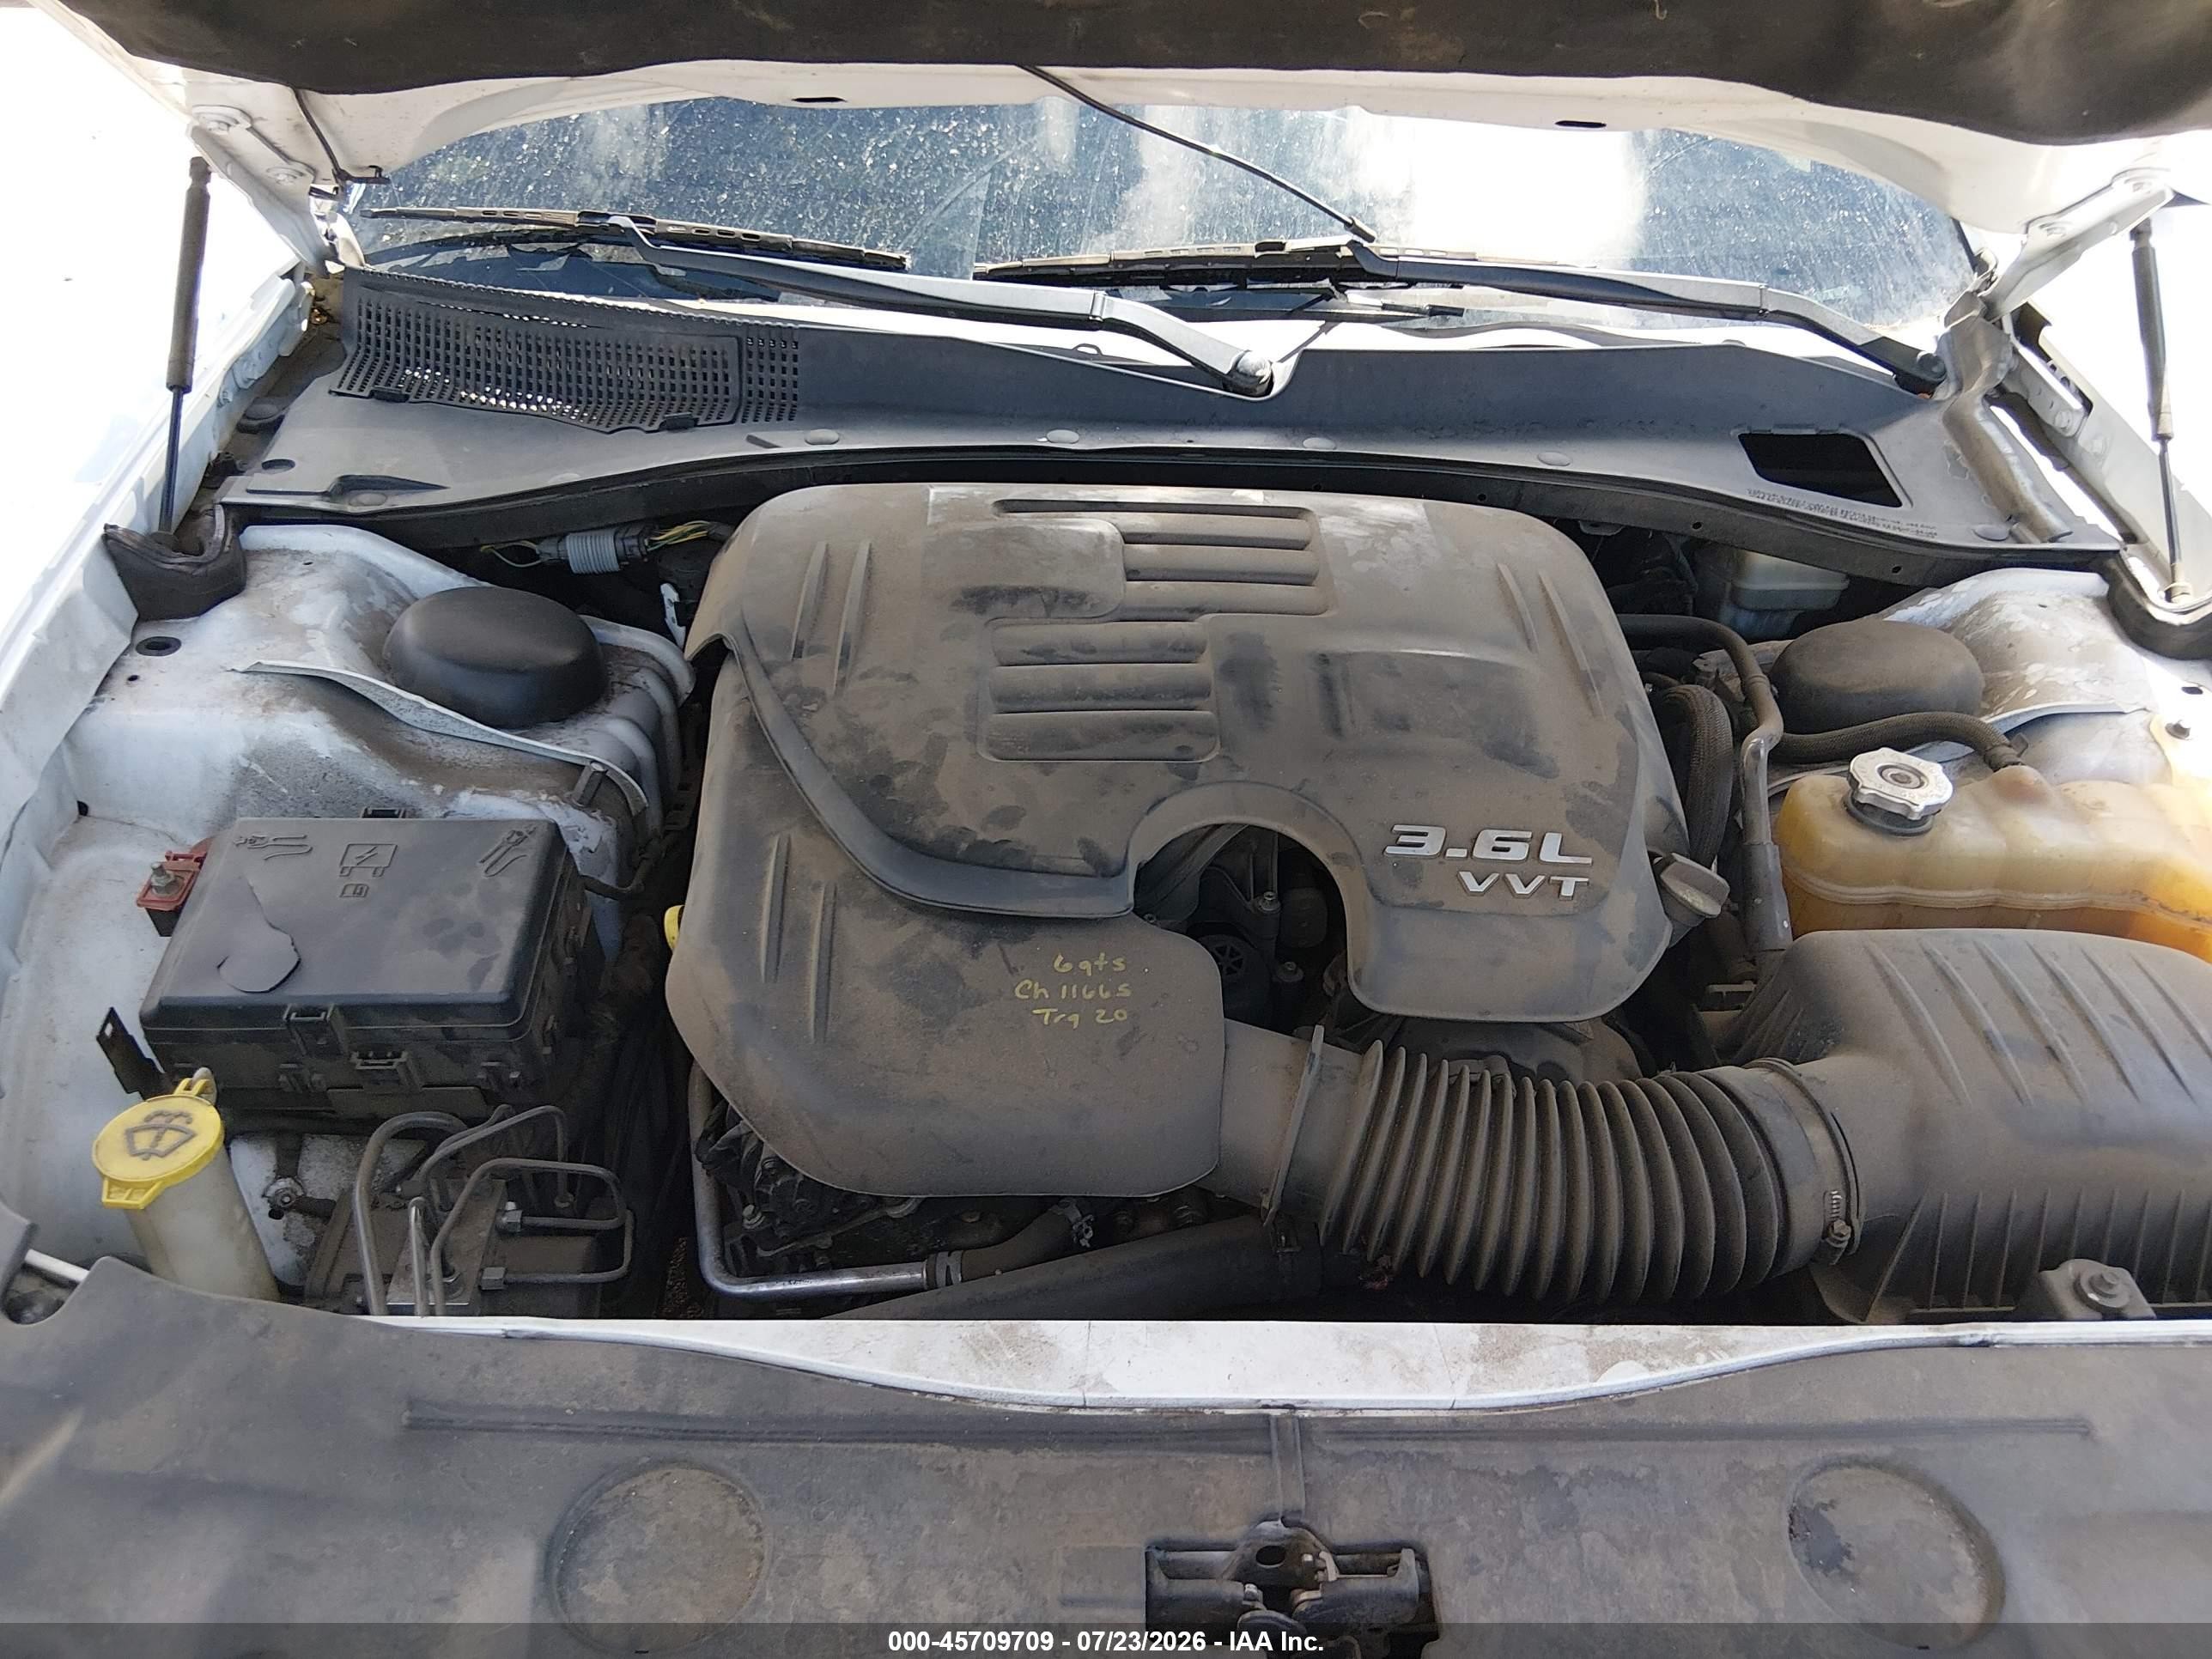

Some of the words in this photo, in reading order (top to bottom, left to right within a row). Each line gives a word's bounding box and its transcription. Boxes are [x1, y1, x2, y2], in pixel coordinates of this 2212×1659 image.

[1383, 824, 1593, 865] 3.6L
[1457, 871, 1589, 900] VVT
[1095, 1008, 1127, 1024] 20
